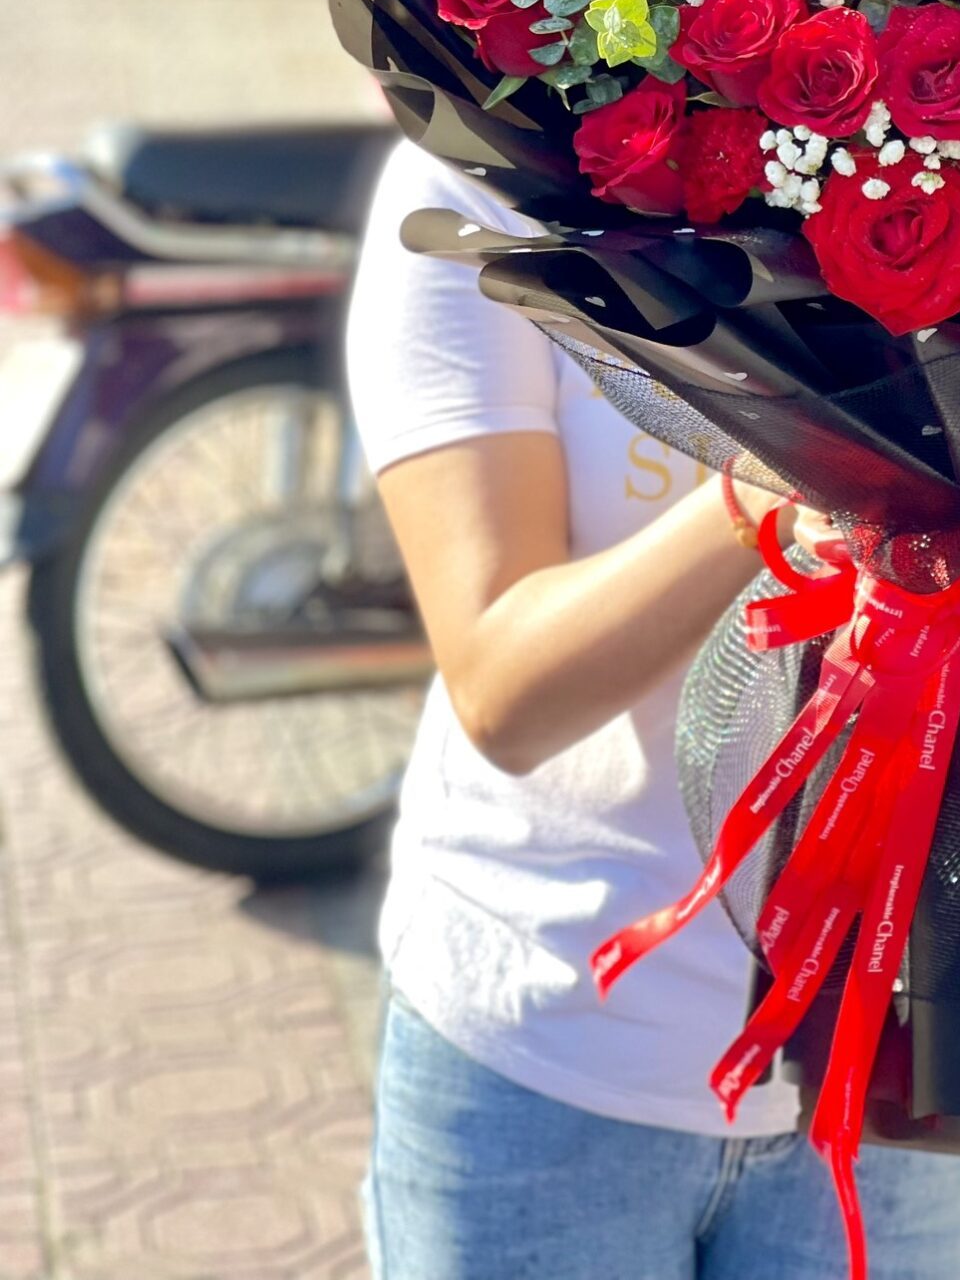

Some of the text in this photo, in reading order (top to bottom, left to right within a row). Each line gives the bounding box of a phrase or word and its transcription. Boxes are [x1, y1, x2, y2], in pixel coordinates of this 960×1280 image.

[774, 726, 817, 778] Chanel
[918, 709, 947, 770] Chanel
[840, 747, 876, 794] Chanel
[866, 920, 894, 973] Chanel
[786, 957, 820, 1002] Chanel
